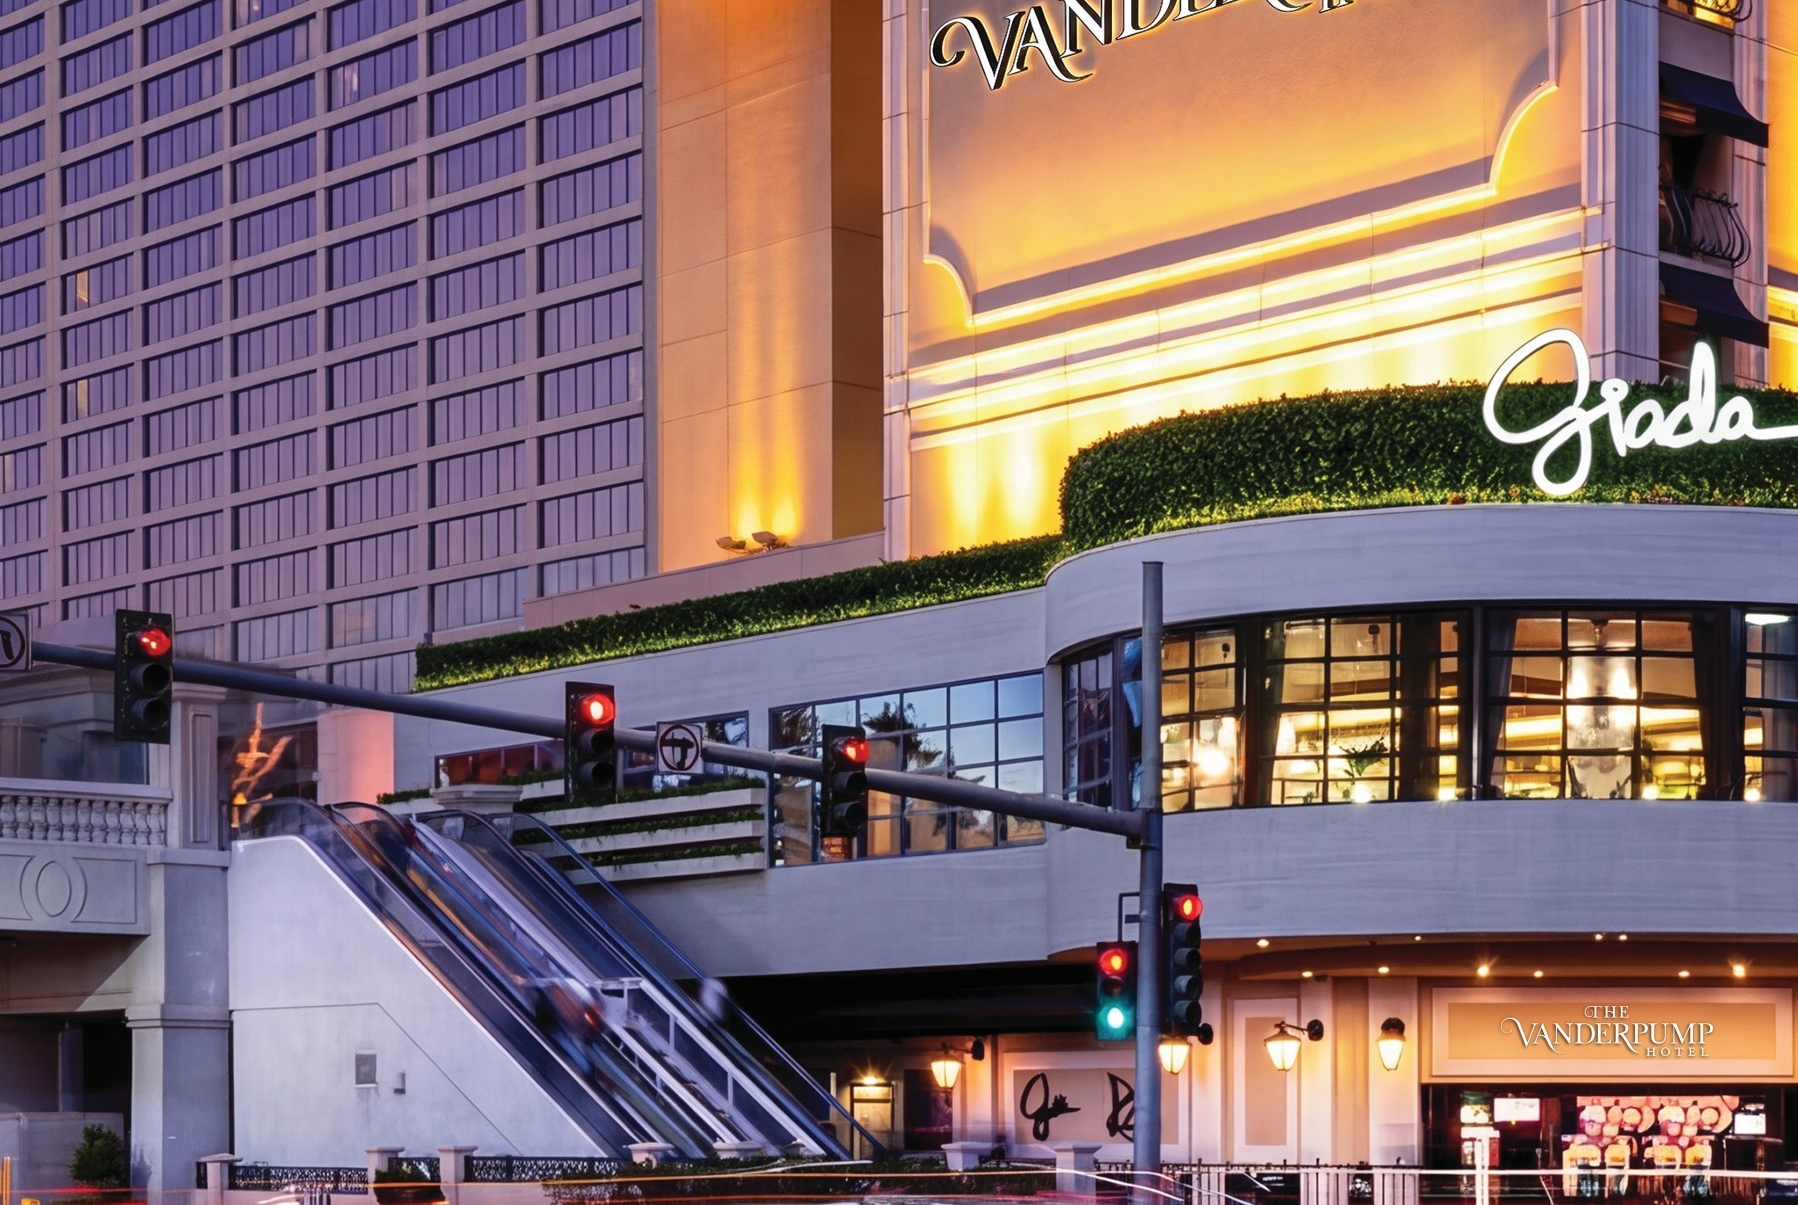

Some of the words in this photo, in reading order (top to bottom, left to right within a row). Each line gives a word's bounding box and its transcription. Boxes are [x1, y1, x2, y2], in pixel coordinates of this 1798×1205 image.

[1584, 1005, 1630, 1019] THE
[1500, 1016, 1714, 1054] VANDERPUMP
[1645, 1047, 1709, 1057] HOTEL
